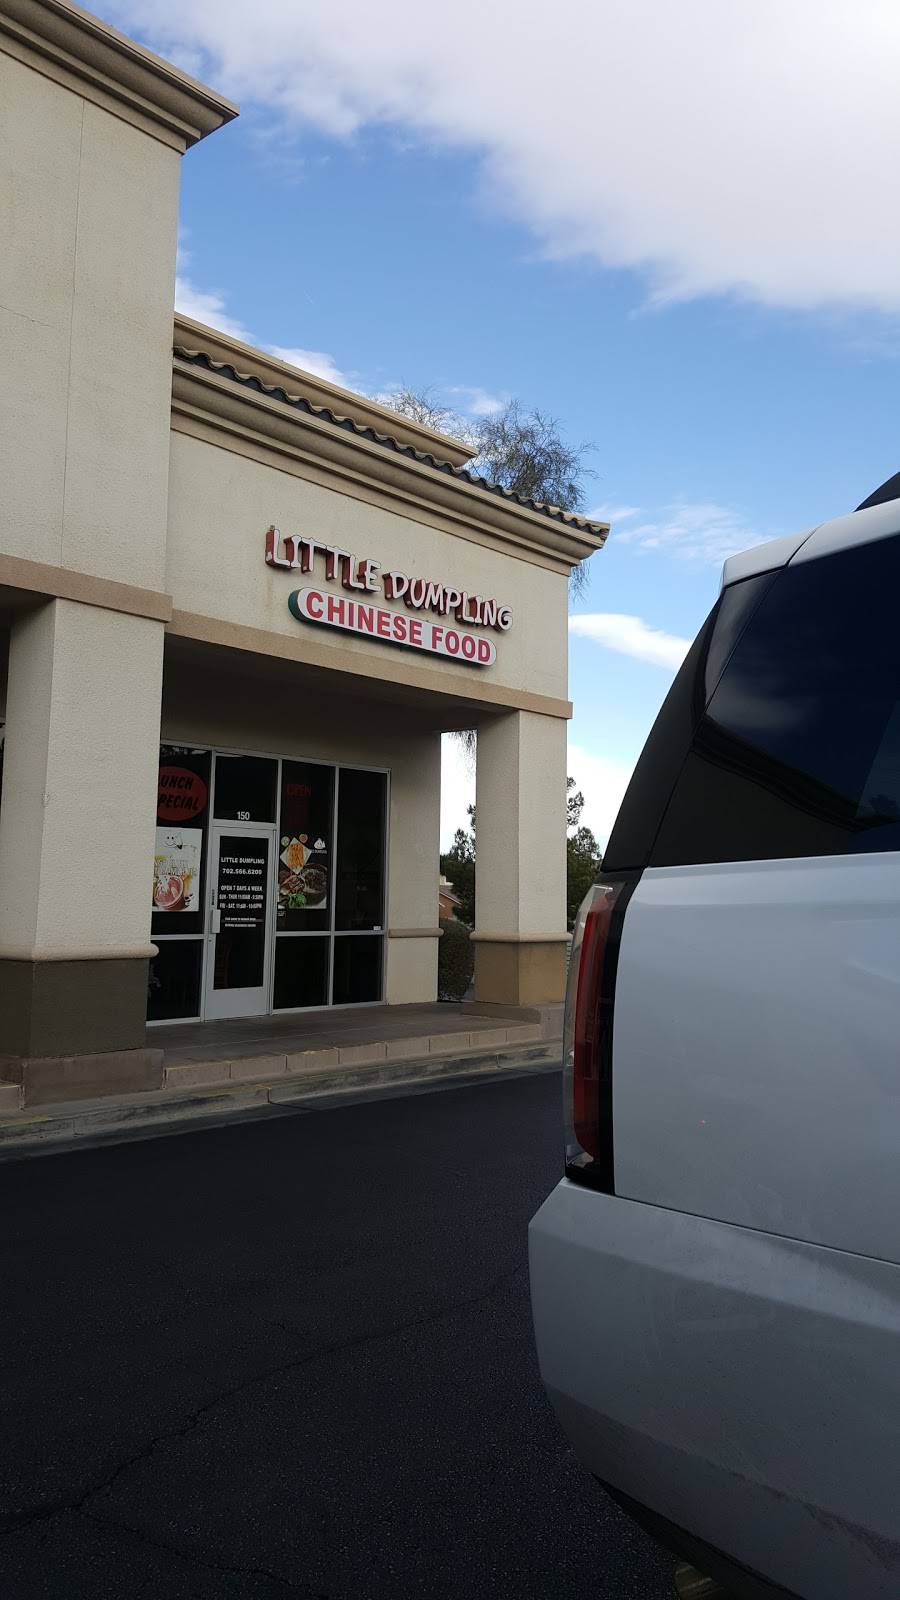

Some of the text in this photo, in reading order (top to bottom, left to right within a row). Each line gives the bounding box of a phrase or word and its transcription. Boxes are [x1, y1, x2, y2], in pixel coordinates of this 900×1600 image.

[266, 528, 513, 630] LITTLE DUMPLING
[306, 591, 491, 663] CHINESE FOOD
[160, 774, 194, 790] UNCH
[159, 793, 200, 811] PECIAL
[237, 811, 250, 821] 150
